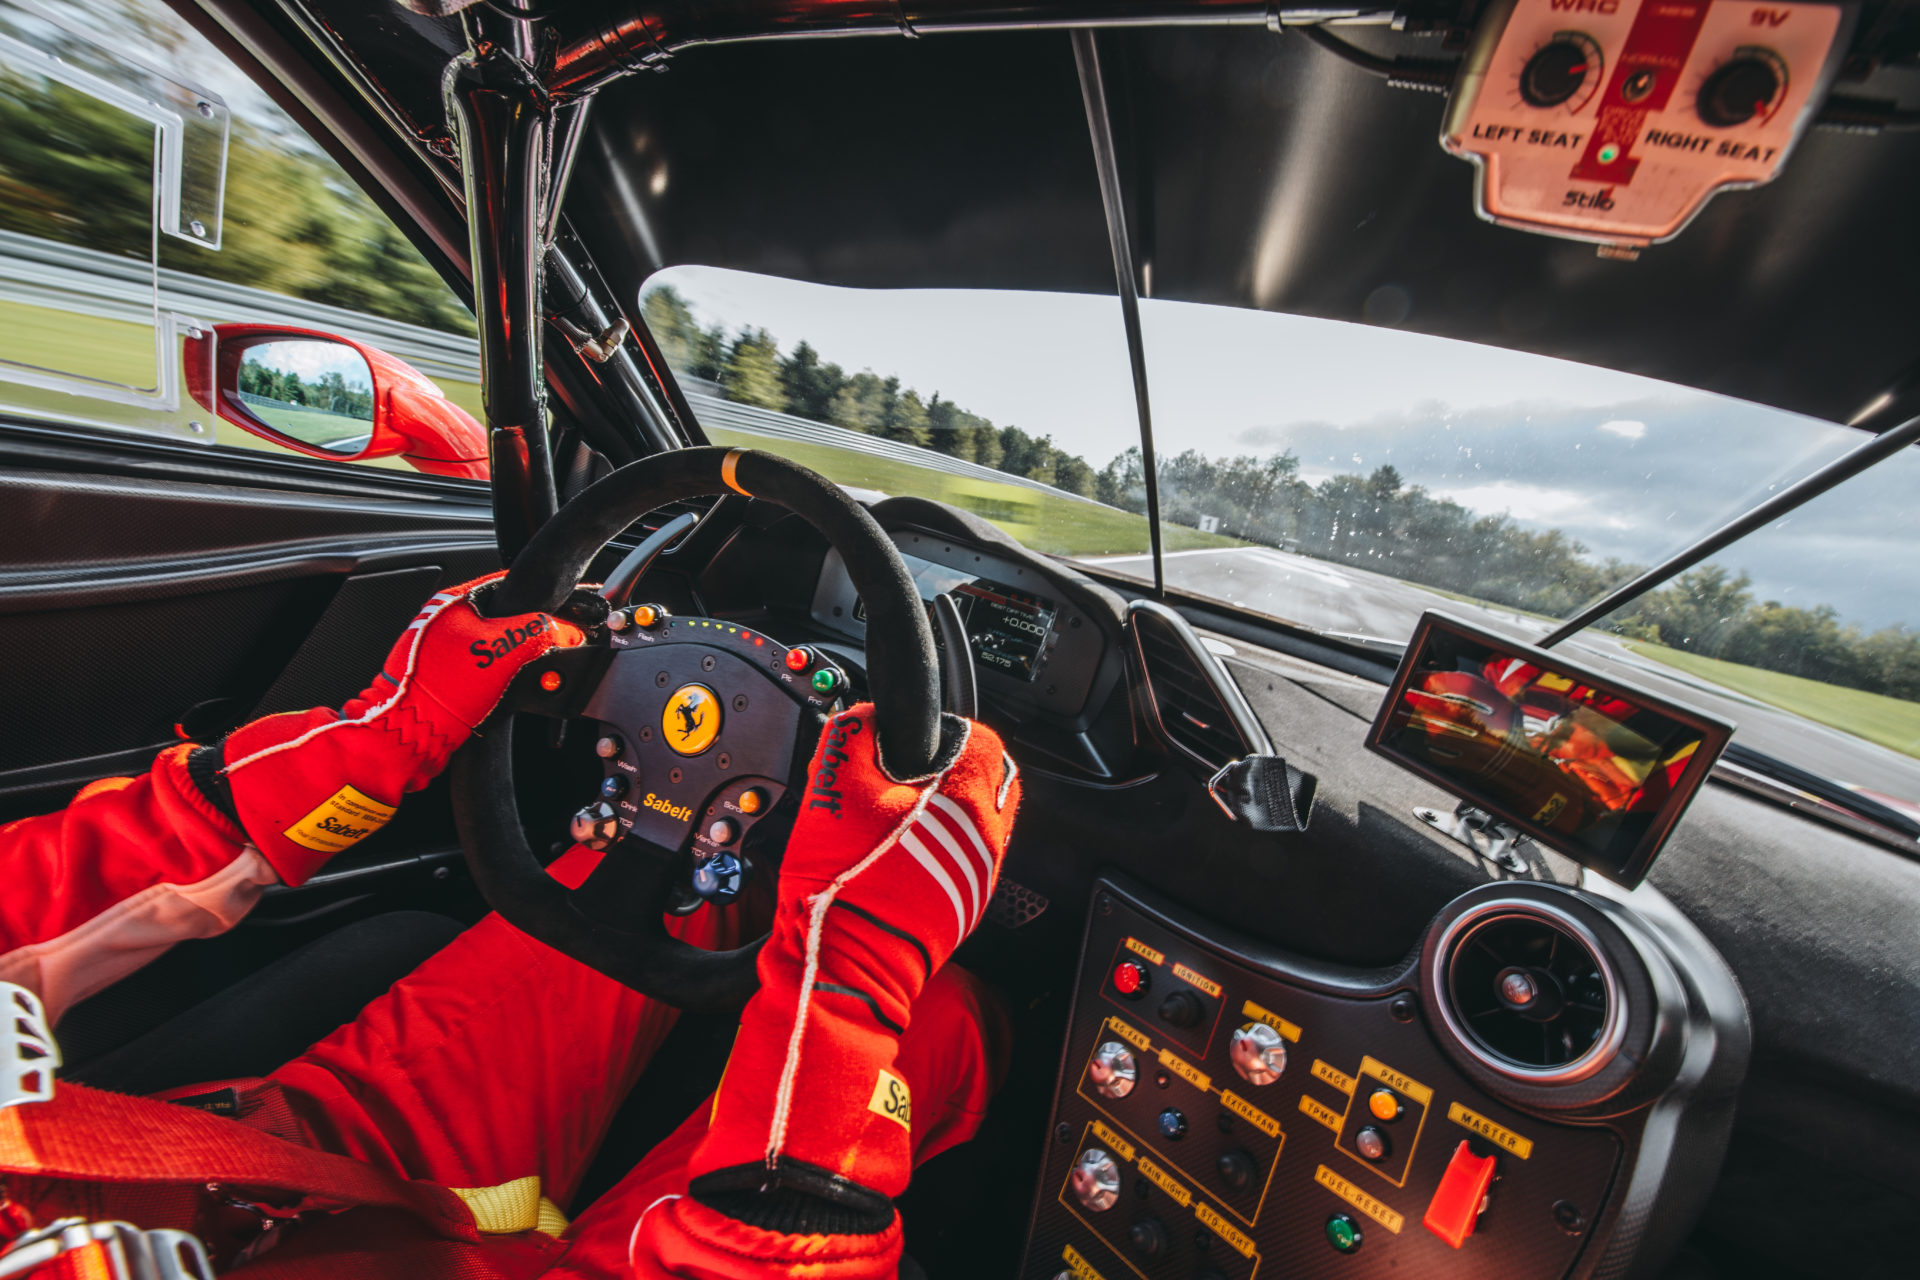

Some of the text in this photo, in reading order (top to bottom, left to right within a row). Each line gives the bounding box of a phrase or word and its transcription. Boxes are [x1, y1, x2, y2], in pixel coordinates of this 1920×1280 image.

[1473, 124, 1583, 149] LEFT SEAT
[1645, 129, 1776, 163] RIGHT SEAT
[1562, 189, 1615, 211] Stilo
[611, 635, 629, 646] Radio
[810, 715, 863, 815] Sabelt
[643, 792, 693, 822] Sabelt
[316, 816, 369, 839] Sabelt
[1131, 942, 1157, 961] START
[1176, 967, 1216, 994] IGNITION
[1379, 1069, 1411, 1093] PAGE
[1224, 1094, 1275, 1132] EXTRA-FAN
[1307, 1102, 1336, 1126] TPMS
[1100, 1127, 1127, 1153] WIPER
[1461, 1111, 1517, 1149] MASTER
[1141, 1162, 1187, 1202] RAIN LIGHT
[1321, 1172, 1395, 1226] FUEL-RESET
[1200, 1208, 1251, 1250] STD-LIGHT
